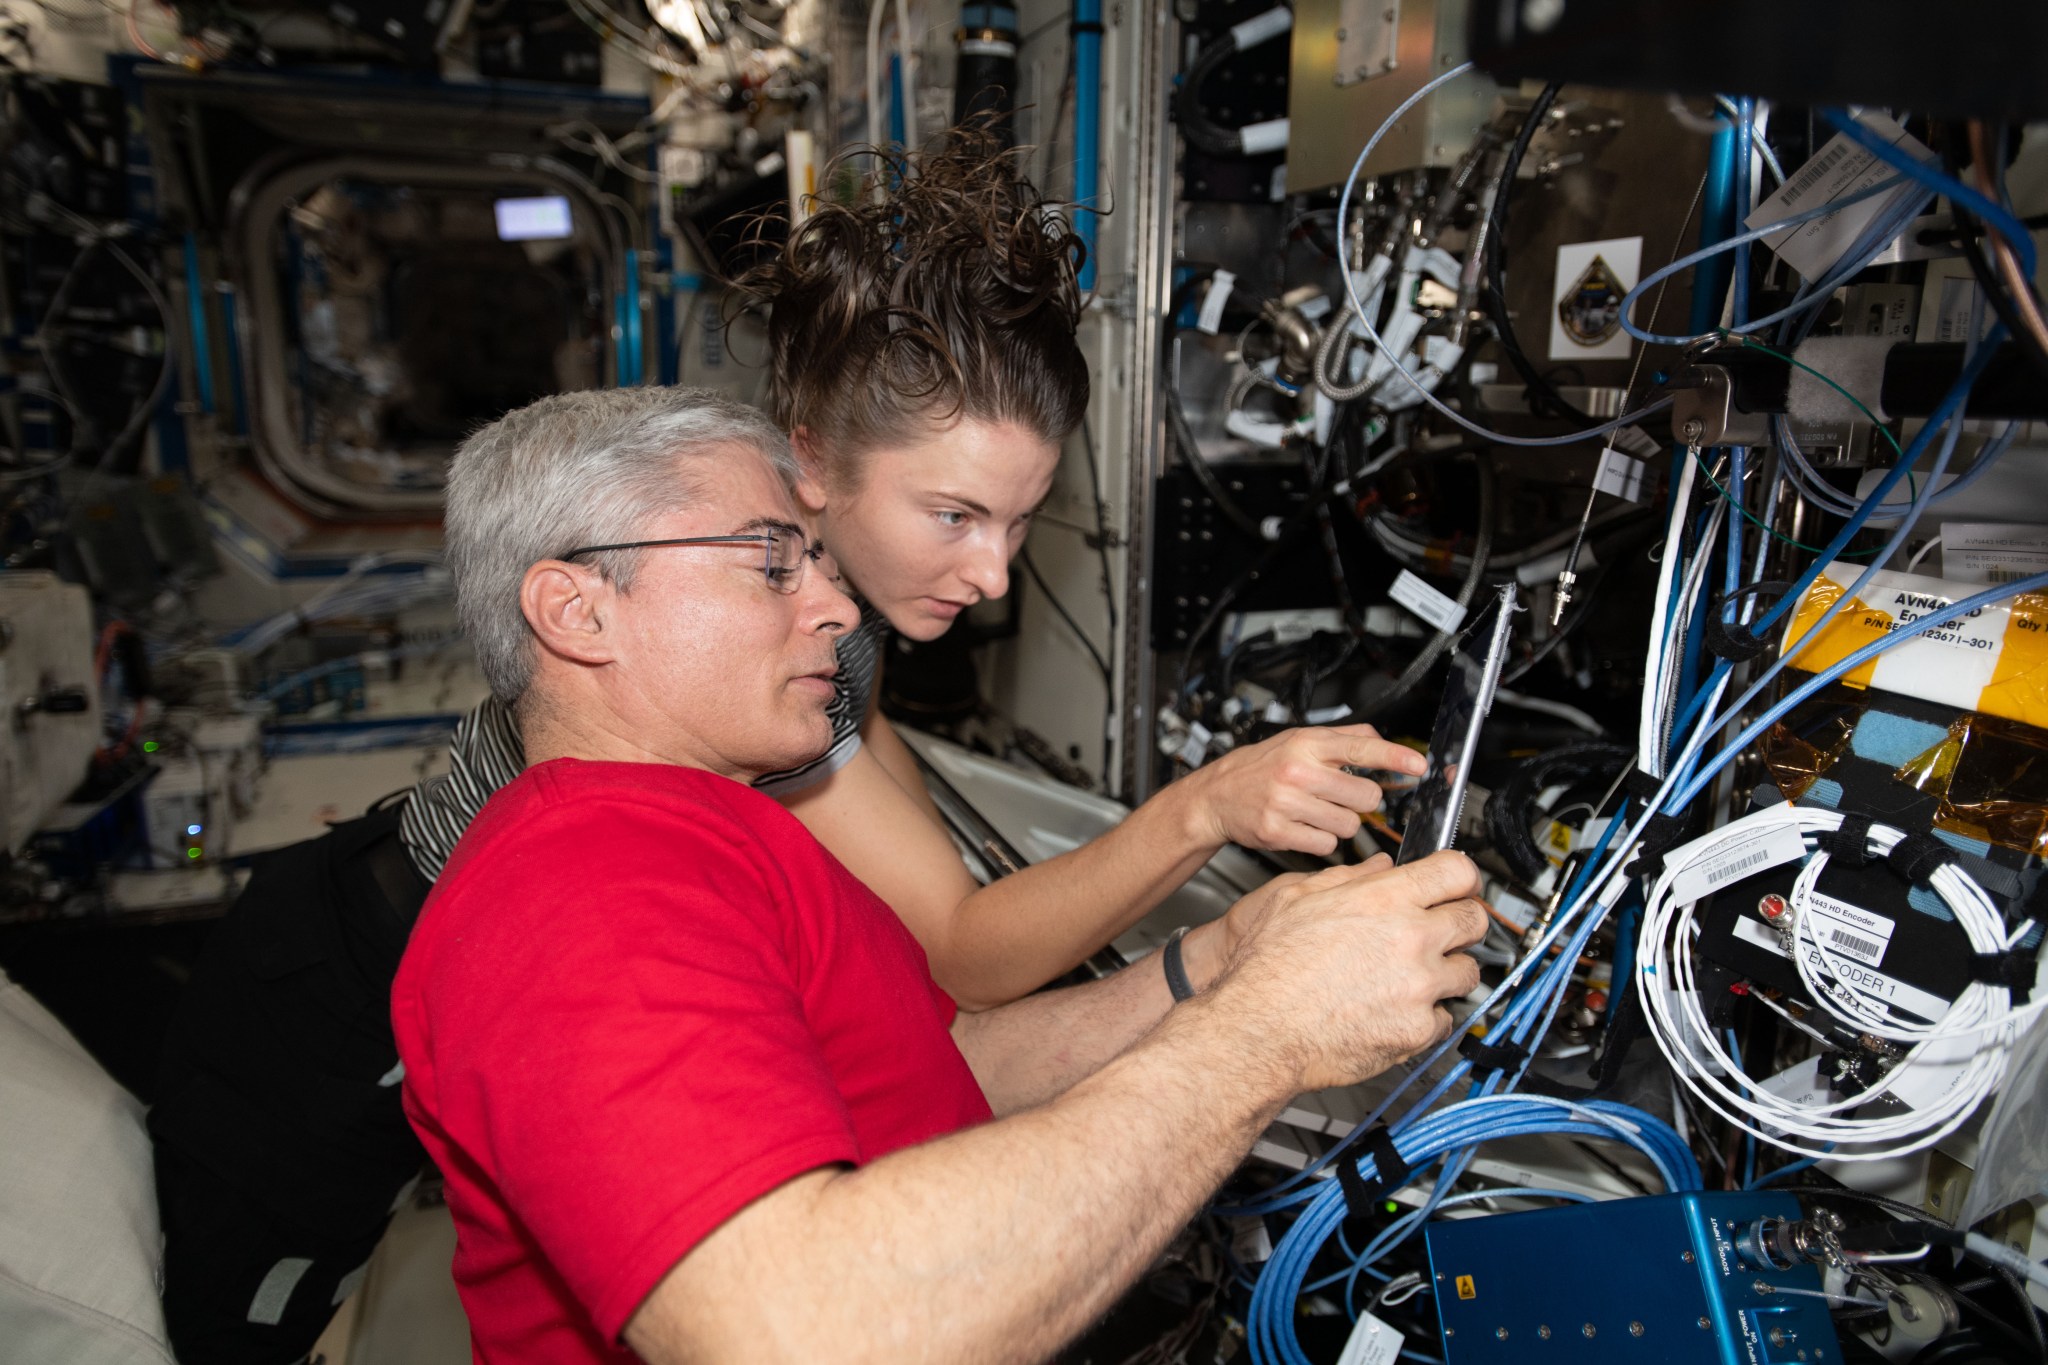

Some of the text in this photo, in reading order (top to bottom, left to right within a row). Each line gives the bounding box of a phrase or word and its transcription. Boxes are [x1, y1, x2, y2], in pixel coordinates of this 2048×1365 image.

[1864, 617, 1885, 631] P/N
[2017, 619, 2041, 632] Qty
[1798, 893, 1876, 928] AN443 HD Encoder
[1887, 984, 1896, 997] 1
[1710, 1217, 1731, 1276] 120VDC INPUT
[1723, 1241, 1730, 1251] J1
[1738, 1309, 1750, 1337] POWER
[1750, 1331, 1758, 1344] ON
